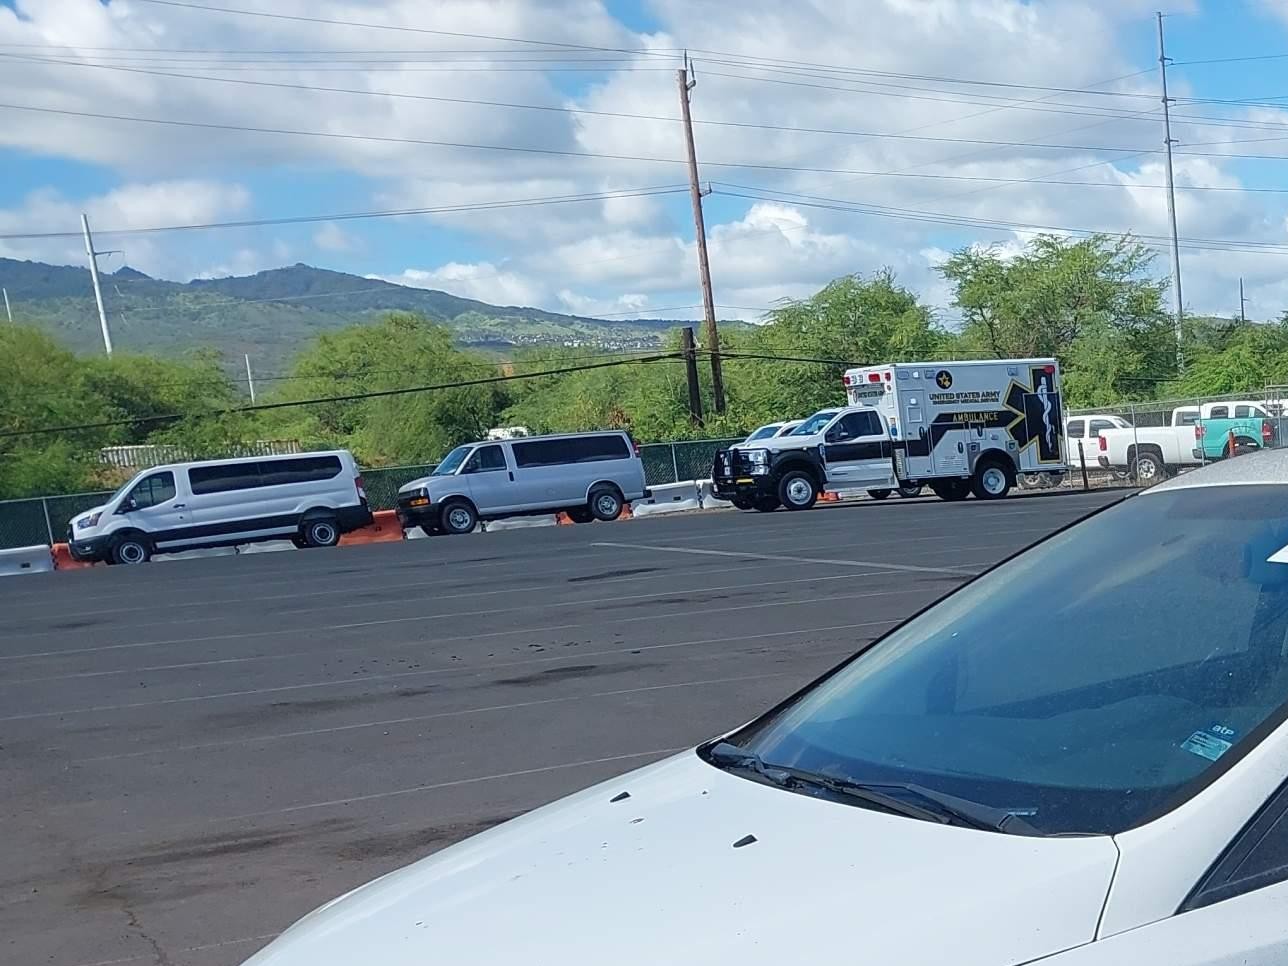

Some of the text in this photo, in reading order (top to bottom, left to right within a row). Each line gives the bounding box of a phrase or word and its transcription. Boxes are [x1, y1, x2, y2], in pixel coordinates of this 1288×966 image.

[929, 391, 1000, 401] UNITED STATES ARMY
[952, 412, 999, 422] AMBULANCE
